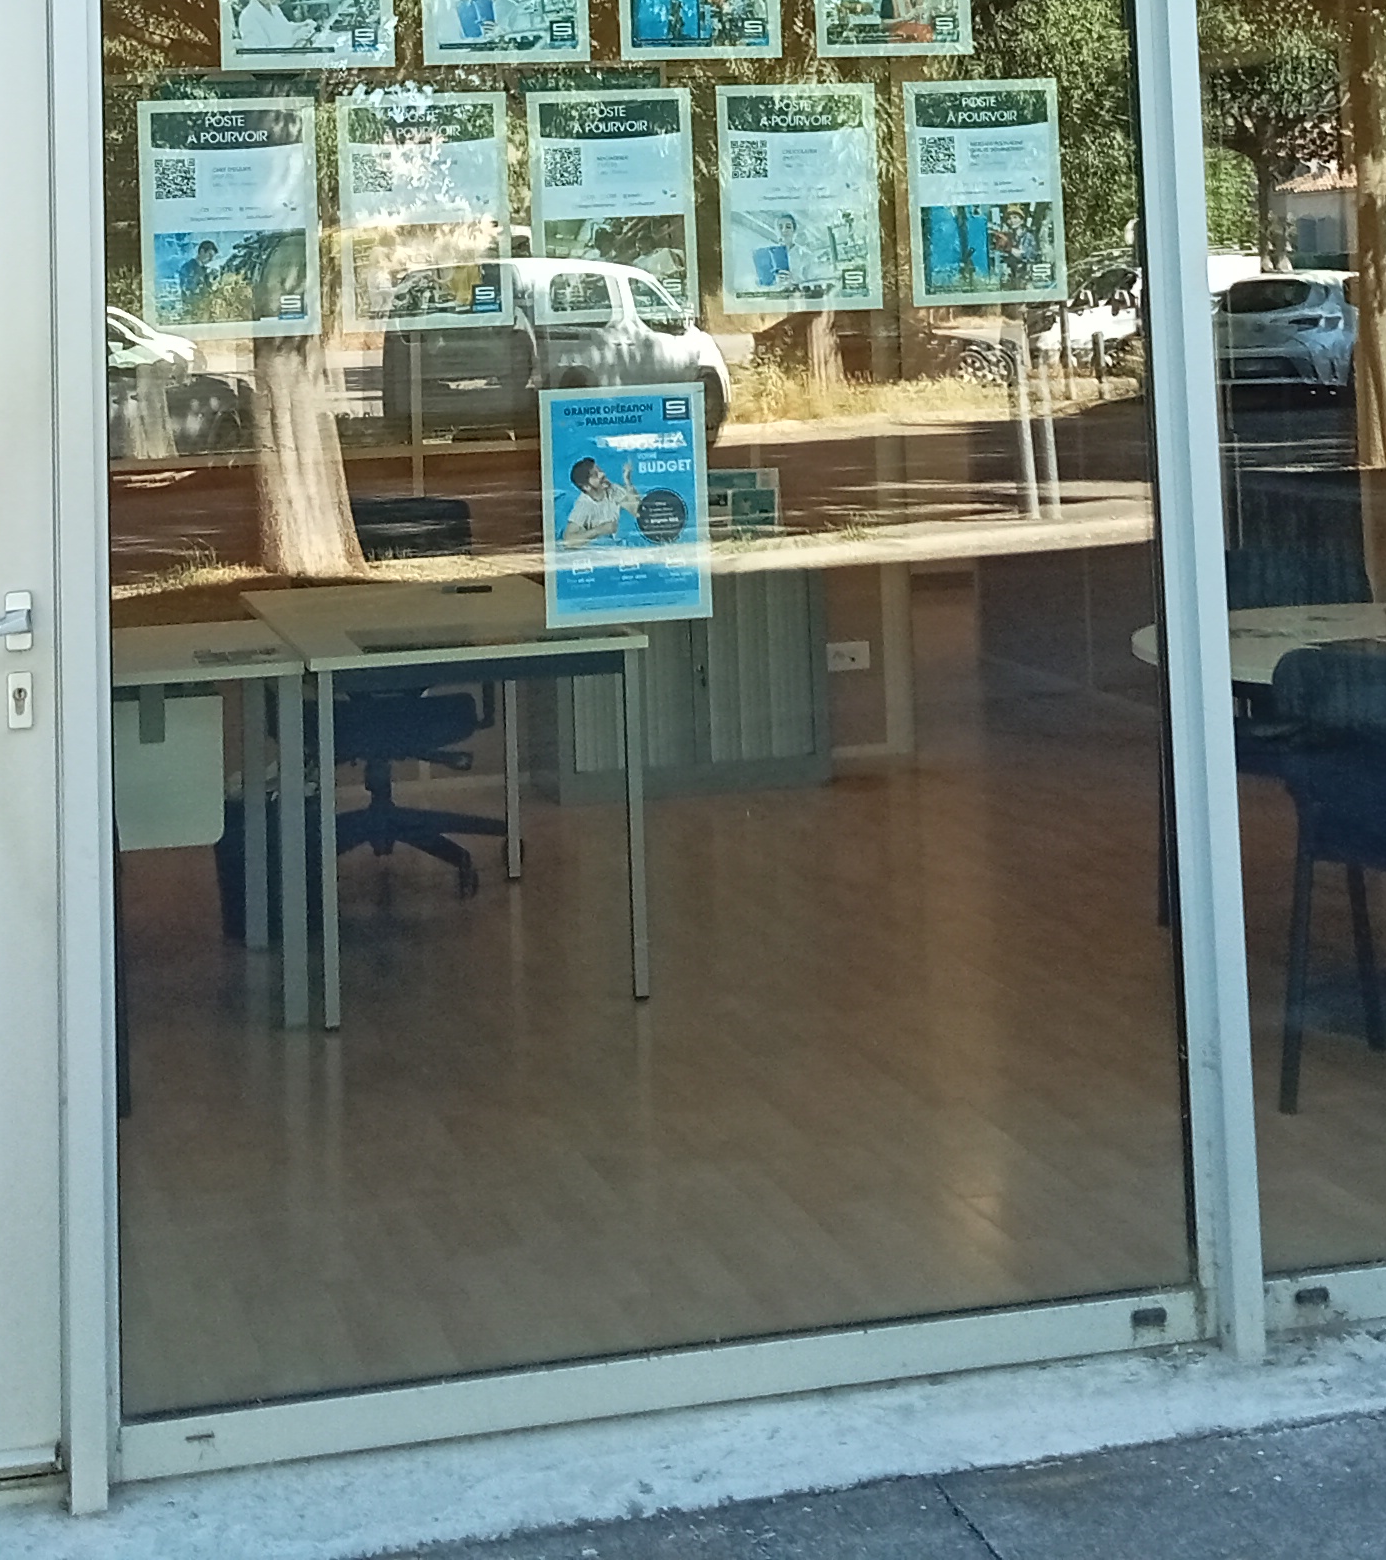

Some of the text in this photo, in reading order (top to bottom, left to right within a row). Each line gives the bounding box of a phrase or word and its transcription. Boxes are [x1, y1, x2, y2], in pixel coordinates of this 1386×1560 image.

[961, 95, 997, 108] POSTE
[589, 104, 627, 118] POSTE
[958, 109, 1018, 123] POURVOIR
[205, 115, 245, 127] POSTE
[585, 120, 648, 134] POURVOIR
[771, 114, 832, 127] POURVOIR
[201, 130, 268, 144] POURVOIR
[563, 406, 602, 417] GRANDE
[585, 415, 644, 427] PARRAINAGE
[638, 459, 692, 474] BUDGET
